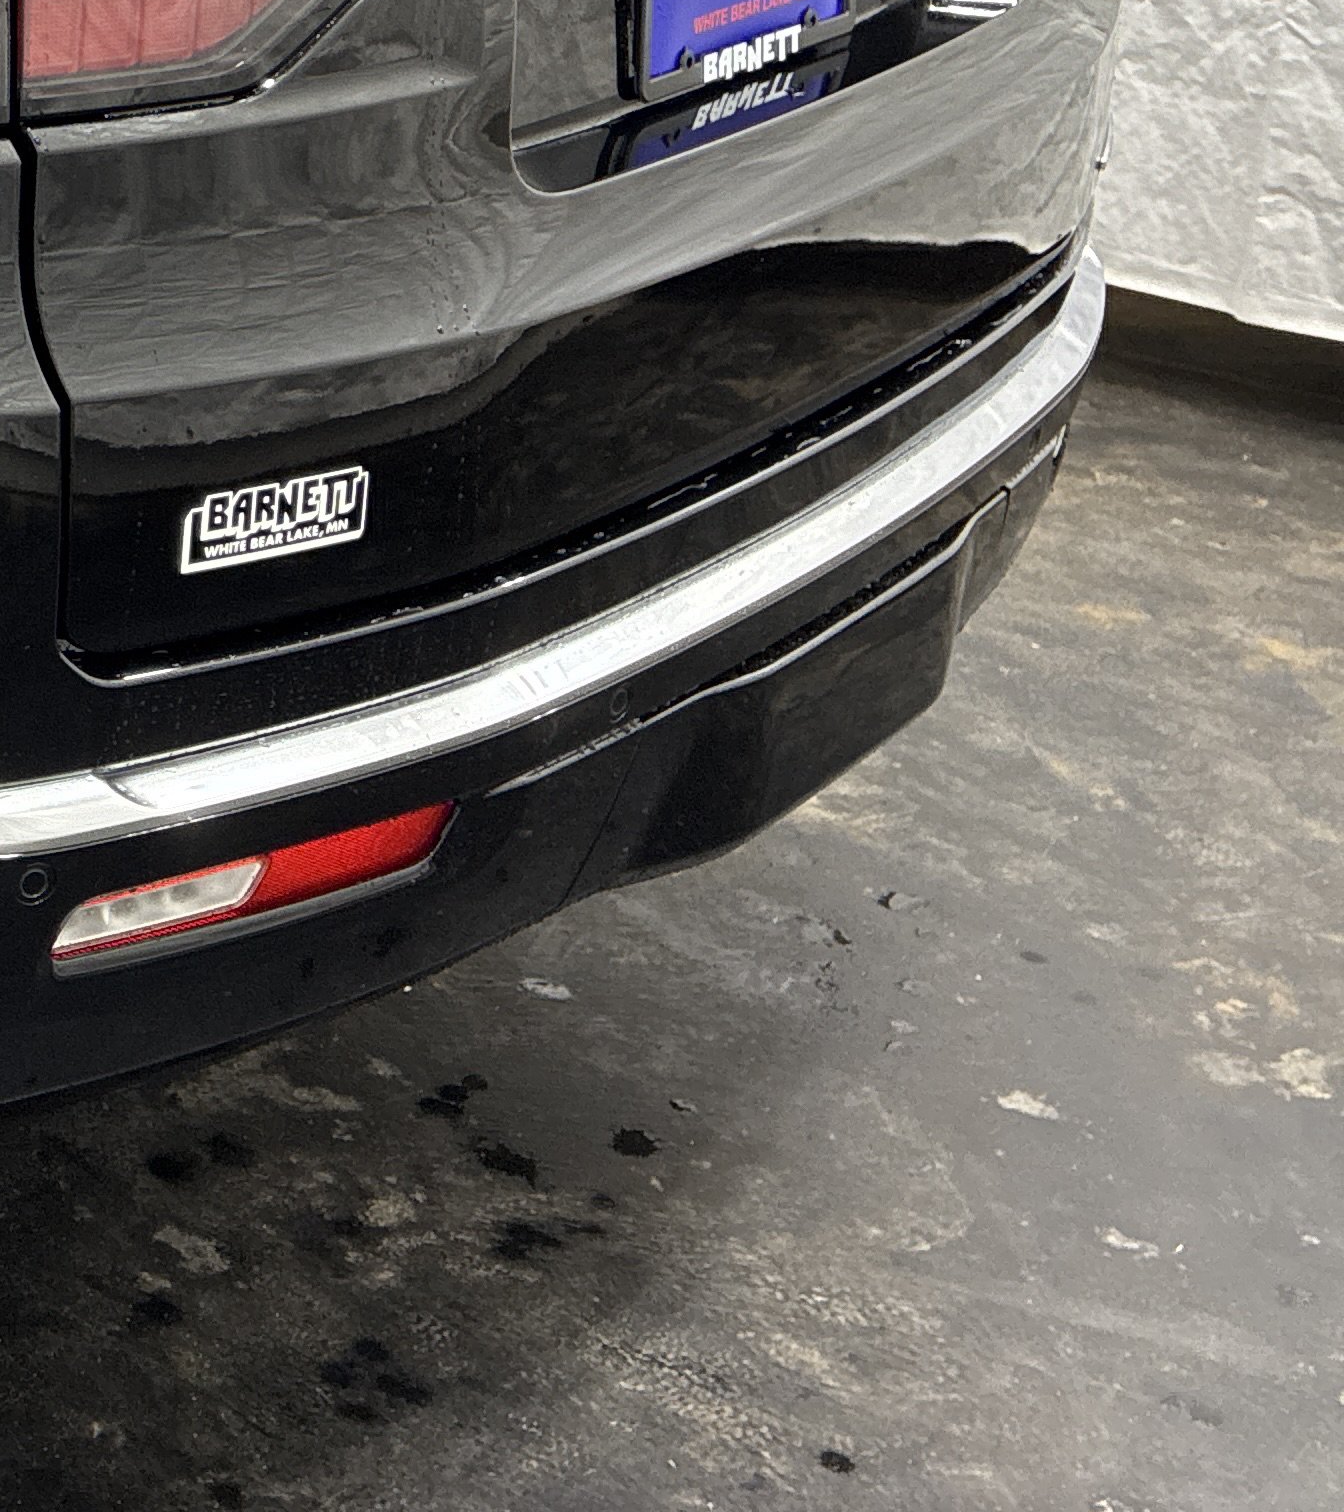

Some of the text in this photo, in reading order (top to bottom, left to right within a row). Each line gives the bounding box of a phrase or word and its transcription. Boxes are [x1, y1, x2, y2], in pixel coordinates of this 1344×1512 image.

[693, 7, 729, 34] WHITE
[703, 24, 802, 84] BARNETT
[205, 468, 362, 536] BARNETT
[204, 518, 349, 559] WHITE BEAR LAKE, MN
